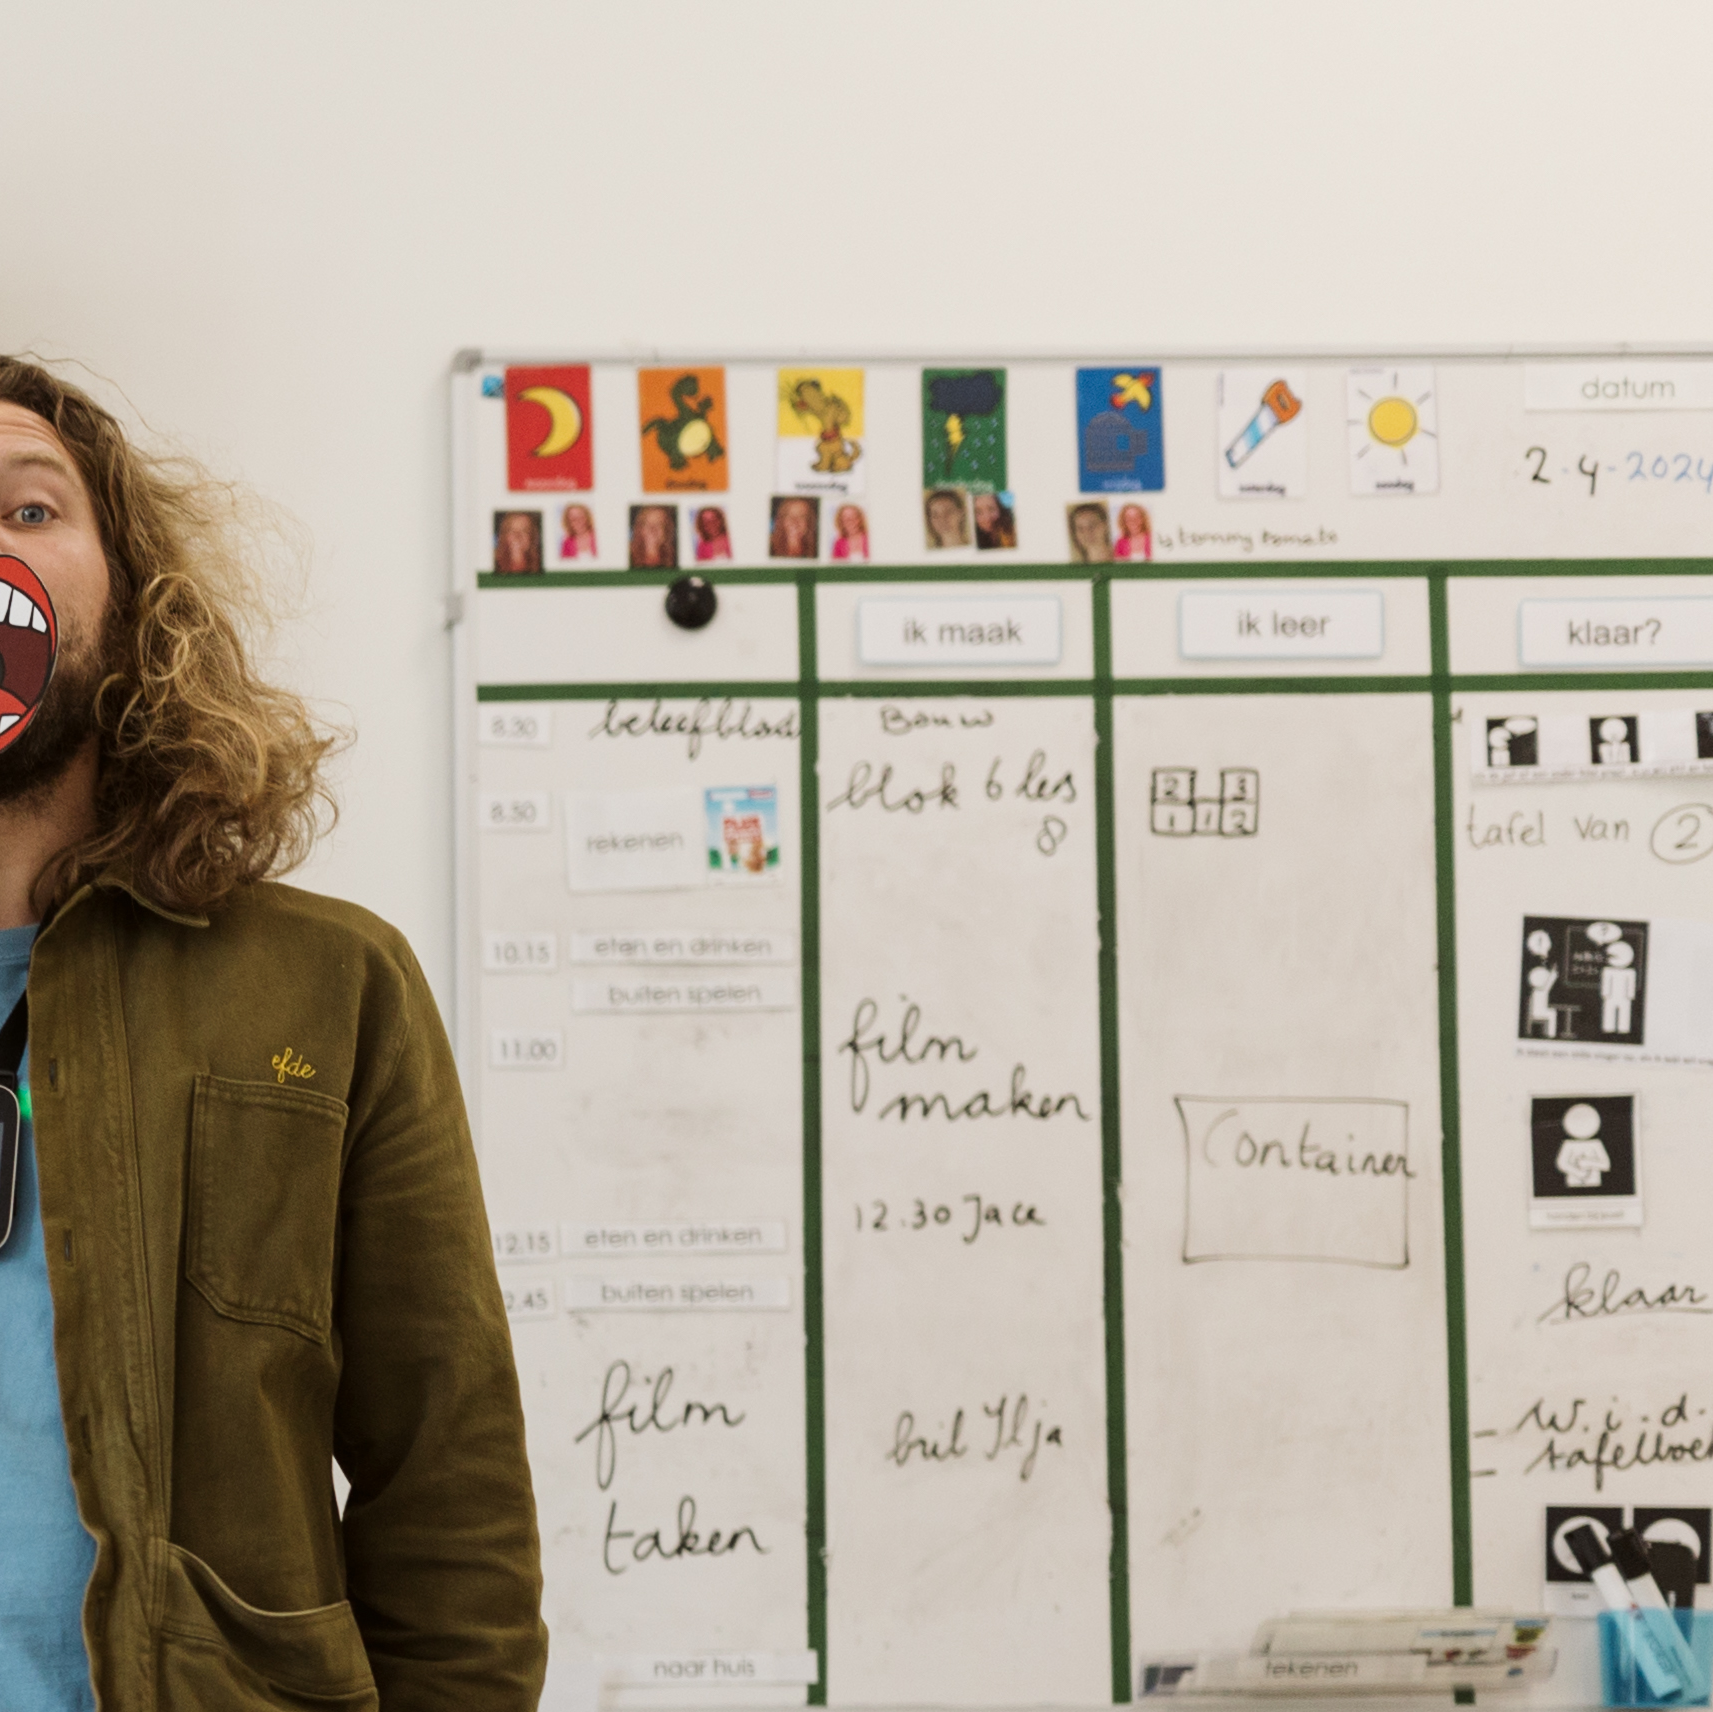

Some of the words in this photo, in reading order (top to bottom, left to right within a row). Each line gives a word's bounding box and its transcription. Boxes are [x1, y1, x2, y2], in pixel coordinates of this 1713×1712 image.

[1581, 375, 1675, 400] datum
[903, 619, 928, 645] ik
[938, 619, 1022, 645] maak
[1237, 612, 1262, 637] ik
[1272, 611, 1331, 638] leer
[1567, 619, 1662, 648] klaar?
[827, 761, 960, 812] blok
[985, 757, 1003, 797] 6
[1015, 750, 1077, 803] les
[1036, 815, 1068, 857] 8
[1466, 803, 1546, 848] tafel
[587, 829, 684, 856] rekenen
[594, 937, 646, 957] eten
[653, 938, 683, 956] en
[690, 936, 772, 956] drinken
[608, 984, 681, 1006] buiten
[687, 983, 762, 1008] spelen
[838, 995, 978, 1113] film
[878, 1064, 1091, 1122] maken
[1203, 1107, 1419, 1180] Container
[854, 1200, 952, 1232] 12.30
[495, 1231, 551, 1255] 12.15
[584, 1229, 637, 1248] eten
[643, 1228, 672, 1248] en
[679, 1226, 763, 1247] drinken
[504, 1287, 549, 1312] 2.45
[601, 1282, 674, 1304] buiten
[680, 1282, 754, 1307] spelen
[1536, 1263, 1707, 1323] klaar
[574, 1359, 746, 1491] film
[603, 1495, 771, 1575] taken
[653, 1657, 706, 1679] naar
[713, 1655, 756, 1678] huis
[1265, 1658, 1359, 1680] tekenen
